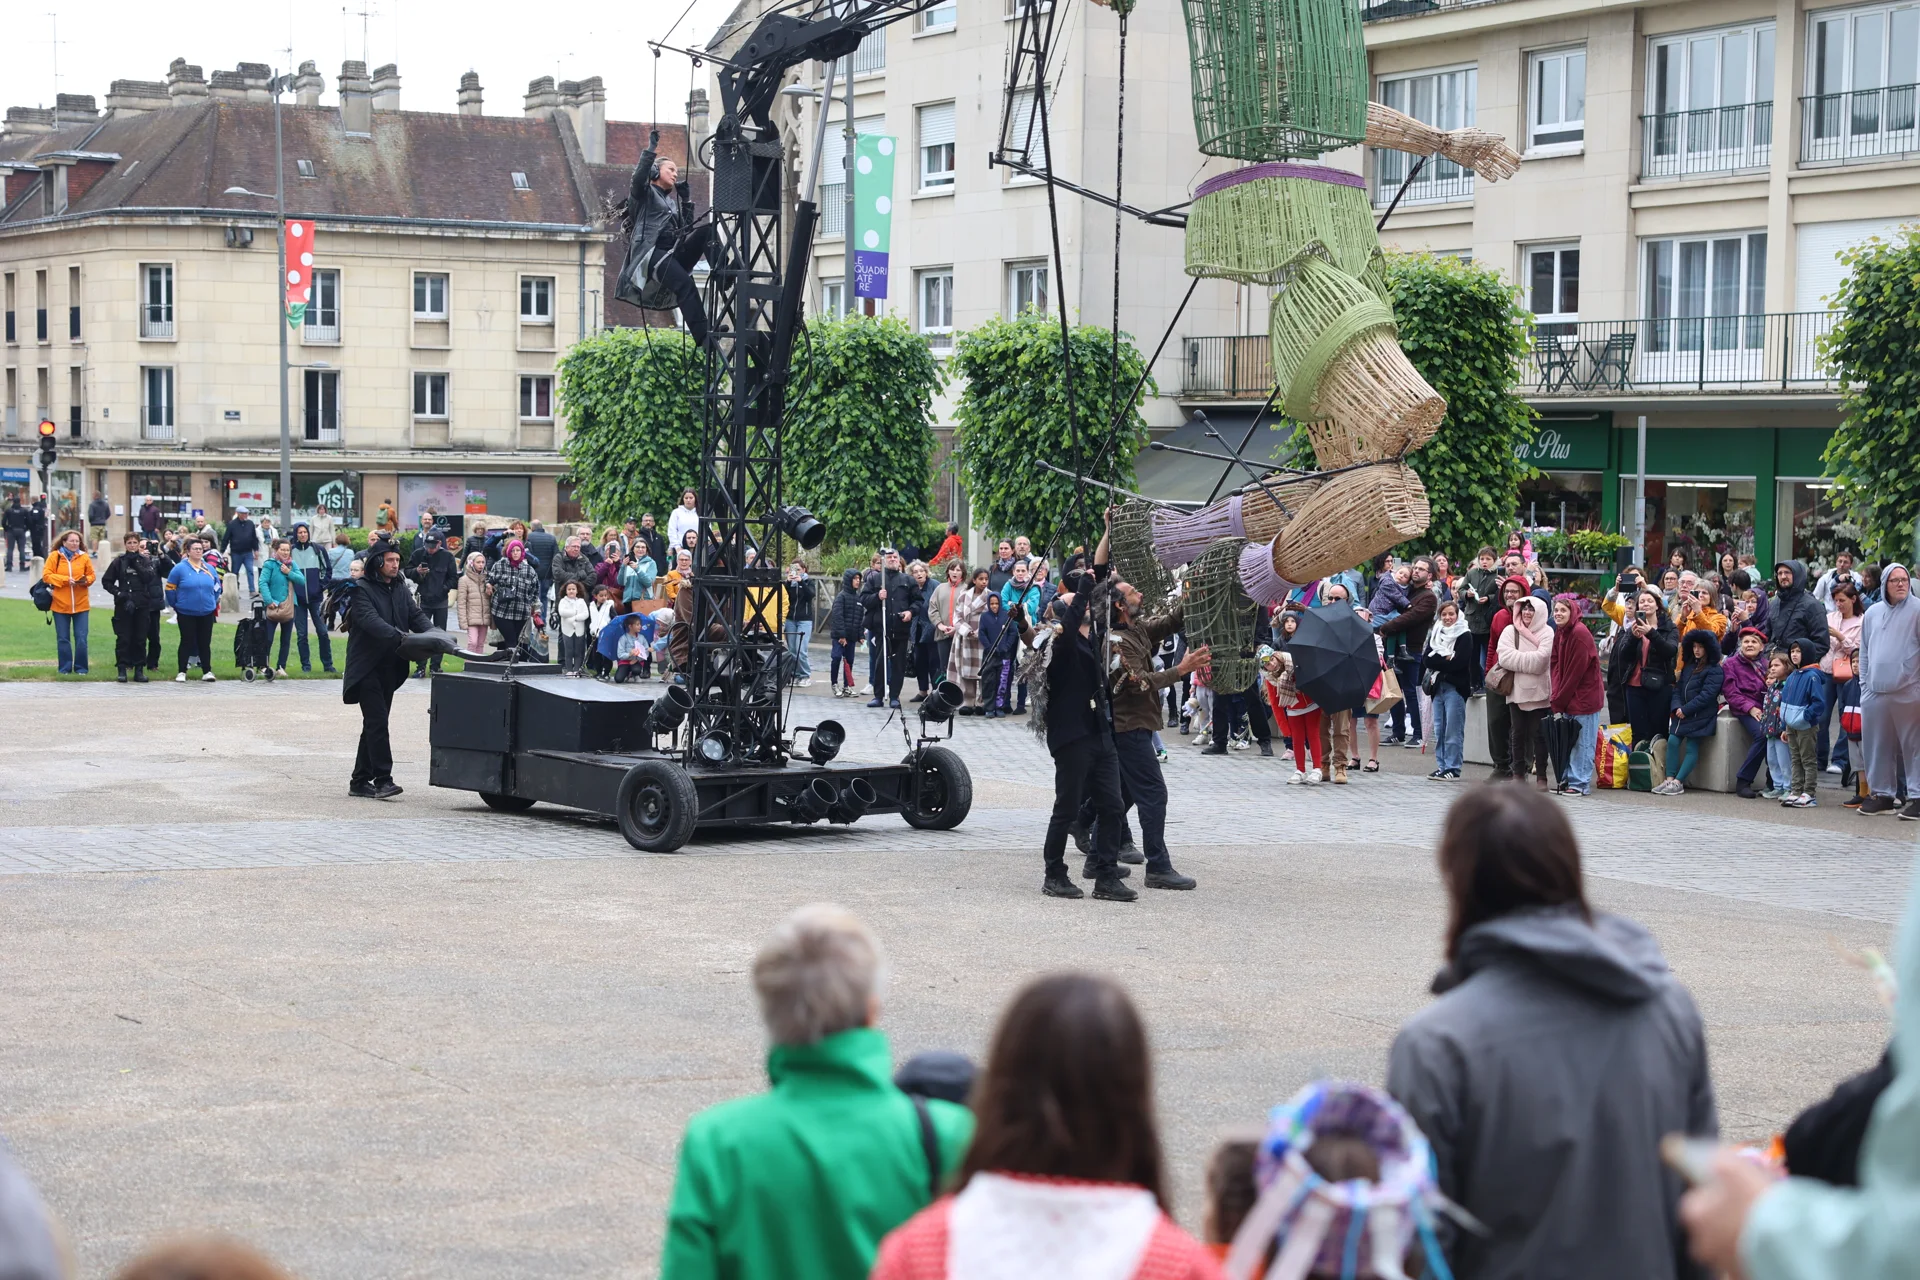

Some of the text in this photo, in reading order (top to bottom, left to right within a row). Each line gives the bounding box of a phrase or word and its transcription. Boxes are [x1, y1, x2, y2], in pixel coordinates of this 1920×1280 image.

[854, 264, 887, 275] QUADRI
[859, 283, 870, 291] RE
[1533, 429, 1571, 459] Plus
